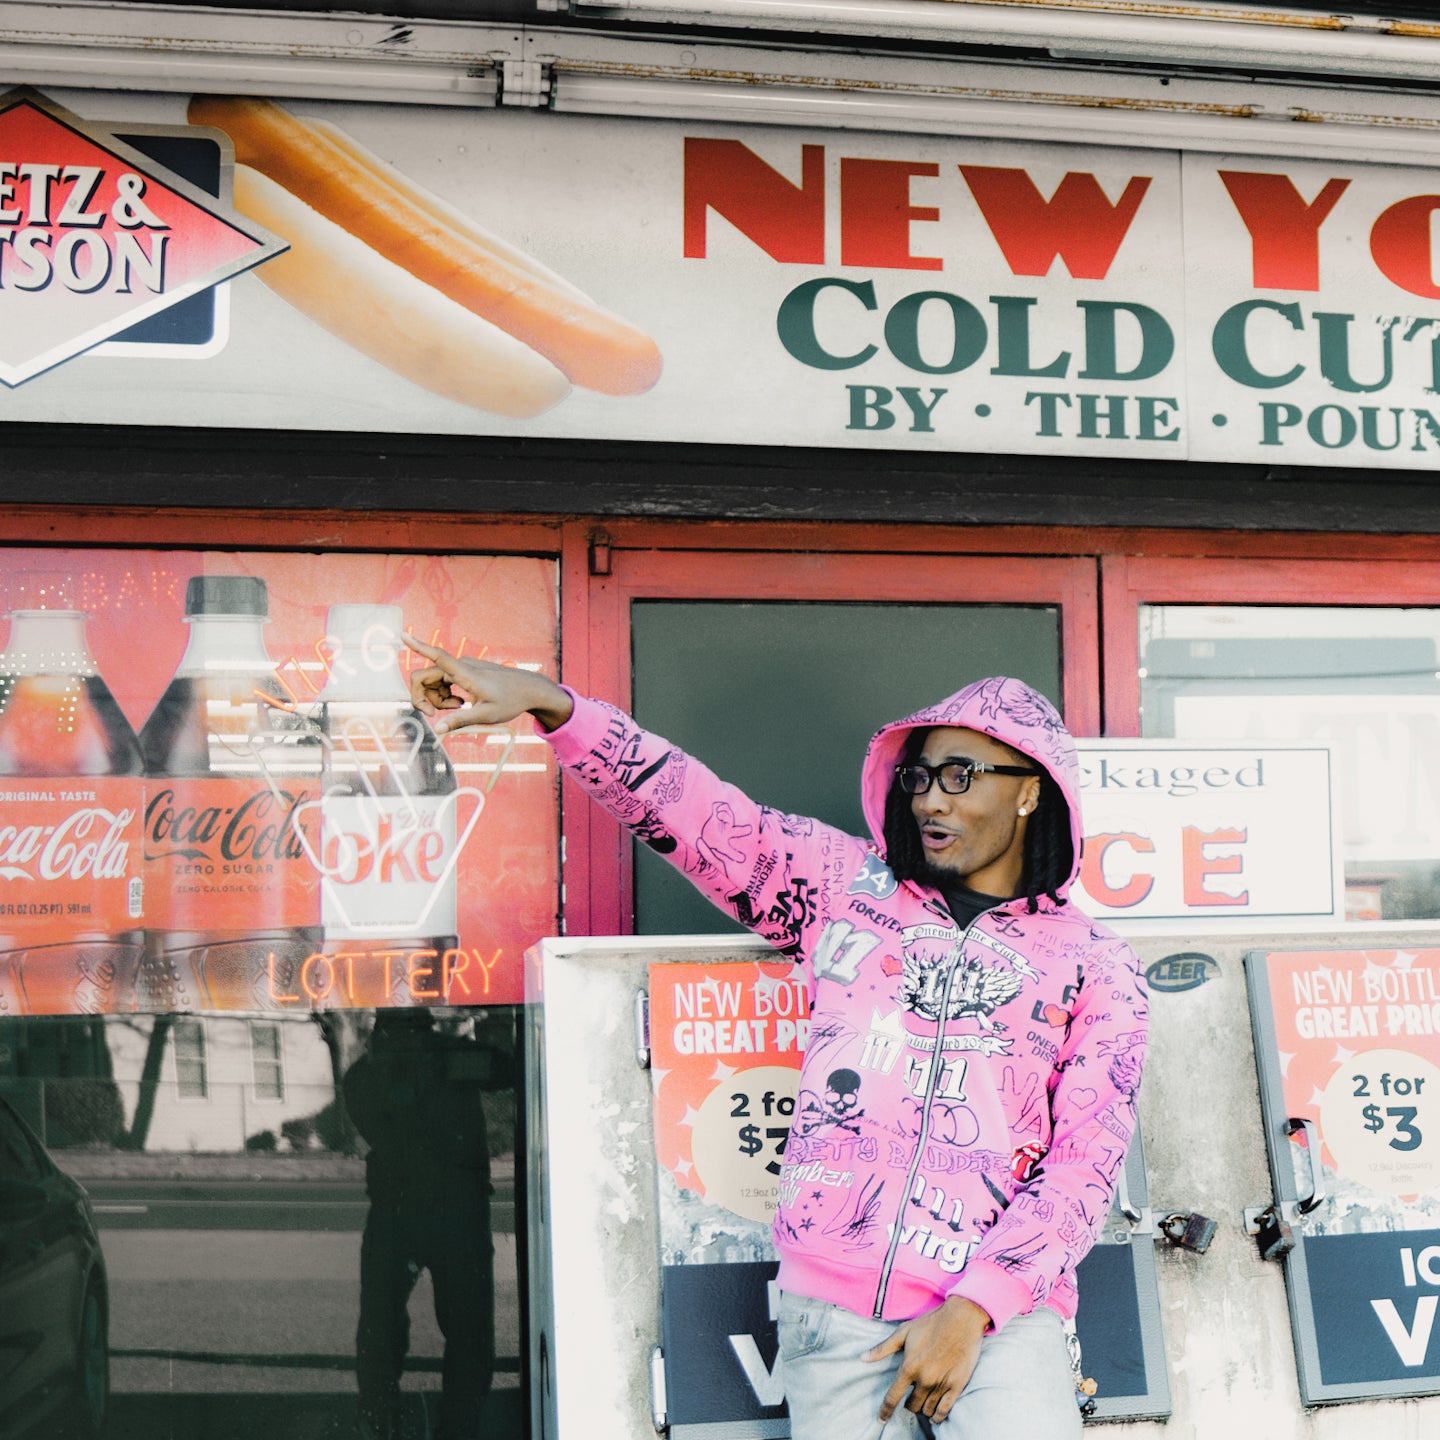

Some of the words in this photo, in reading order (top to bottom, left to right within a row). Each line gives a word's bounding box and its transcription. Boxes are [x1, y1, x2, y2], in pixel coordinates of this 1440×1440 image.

[111, 173, 172, 230] &
[684, 137, 1153, 280] NEW
[777, 277, 1175, 381] COLD
[845, 385, 948, 432] BY
[1024, 391, 1180, 441] THE
[59, 791, 97, 801] TASTE
[145, 789, 311, 861] Coca-Cola
[320, 812, 444, 885] oke
[175, 864, 214, 875] ZERO
[222, 863, 274, 875] SUGAR
[268, 945, 503, 1001] LOTTERY
[1155, 961, 1207, 980] LEER
[1292, 969, 1353, 1006] NEW
[674, 982, 743, 1019] NEW
[673, 1020, 768, 1055] GREAT
[1295, 1005, 1380, 1040] GREAT
[1351, 1074, 1371, 1097] 2
[1380, 1072, 1426, 1097] for
[730, 1093, 751, 1118] 2
[1362, 1103, 1423, 1152] $3
[740, 1187, 769, 1198] 12.9oz
